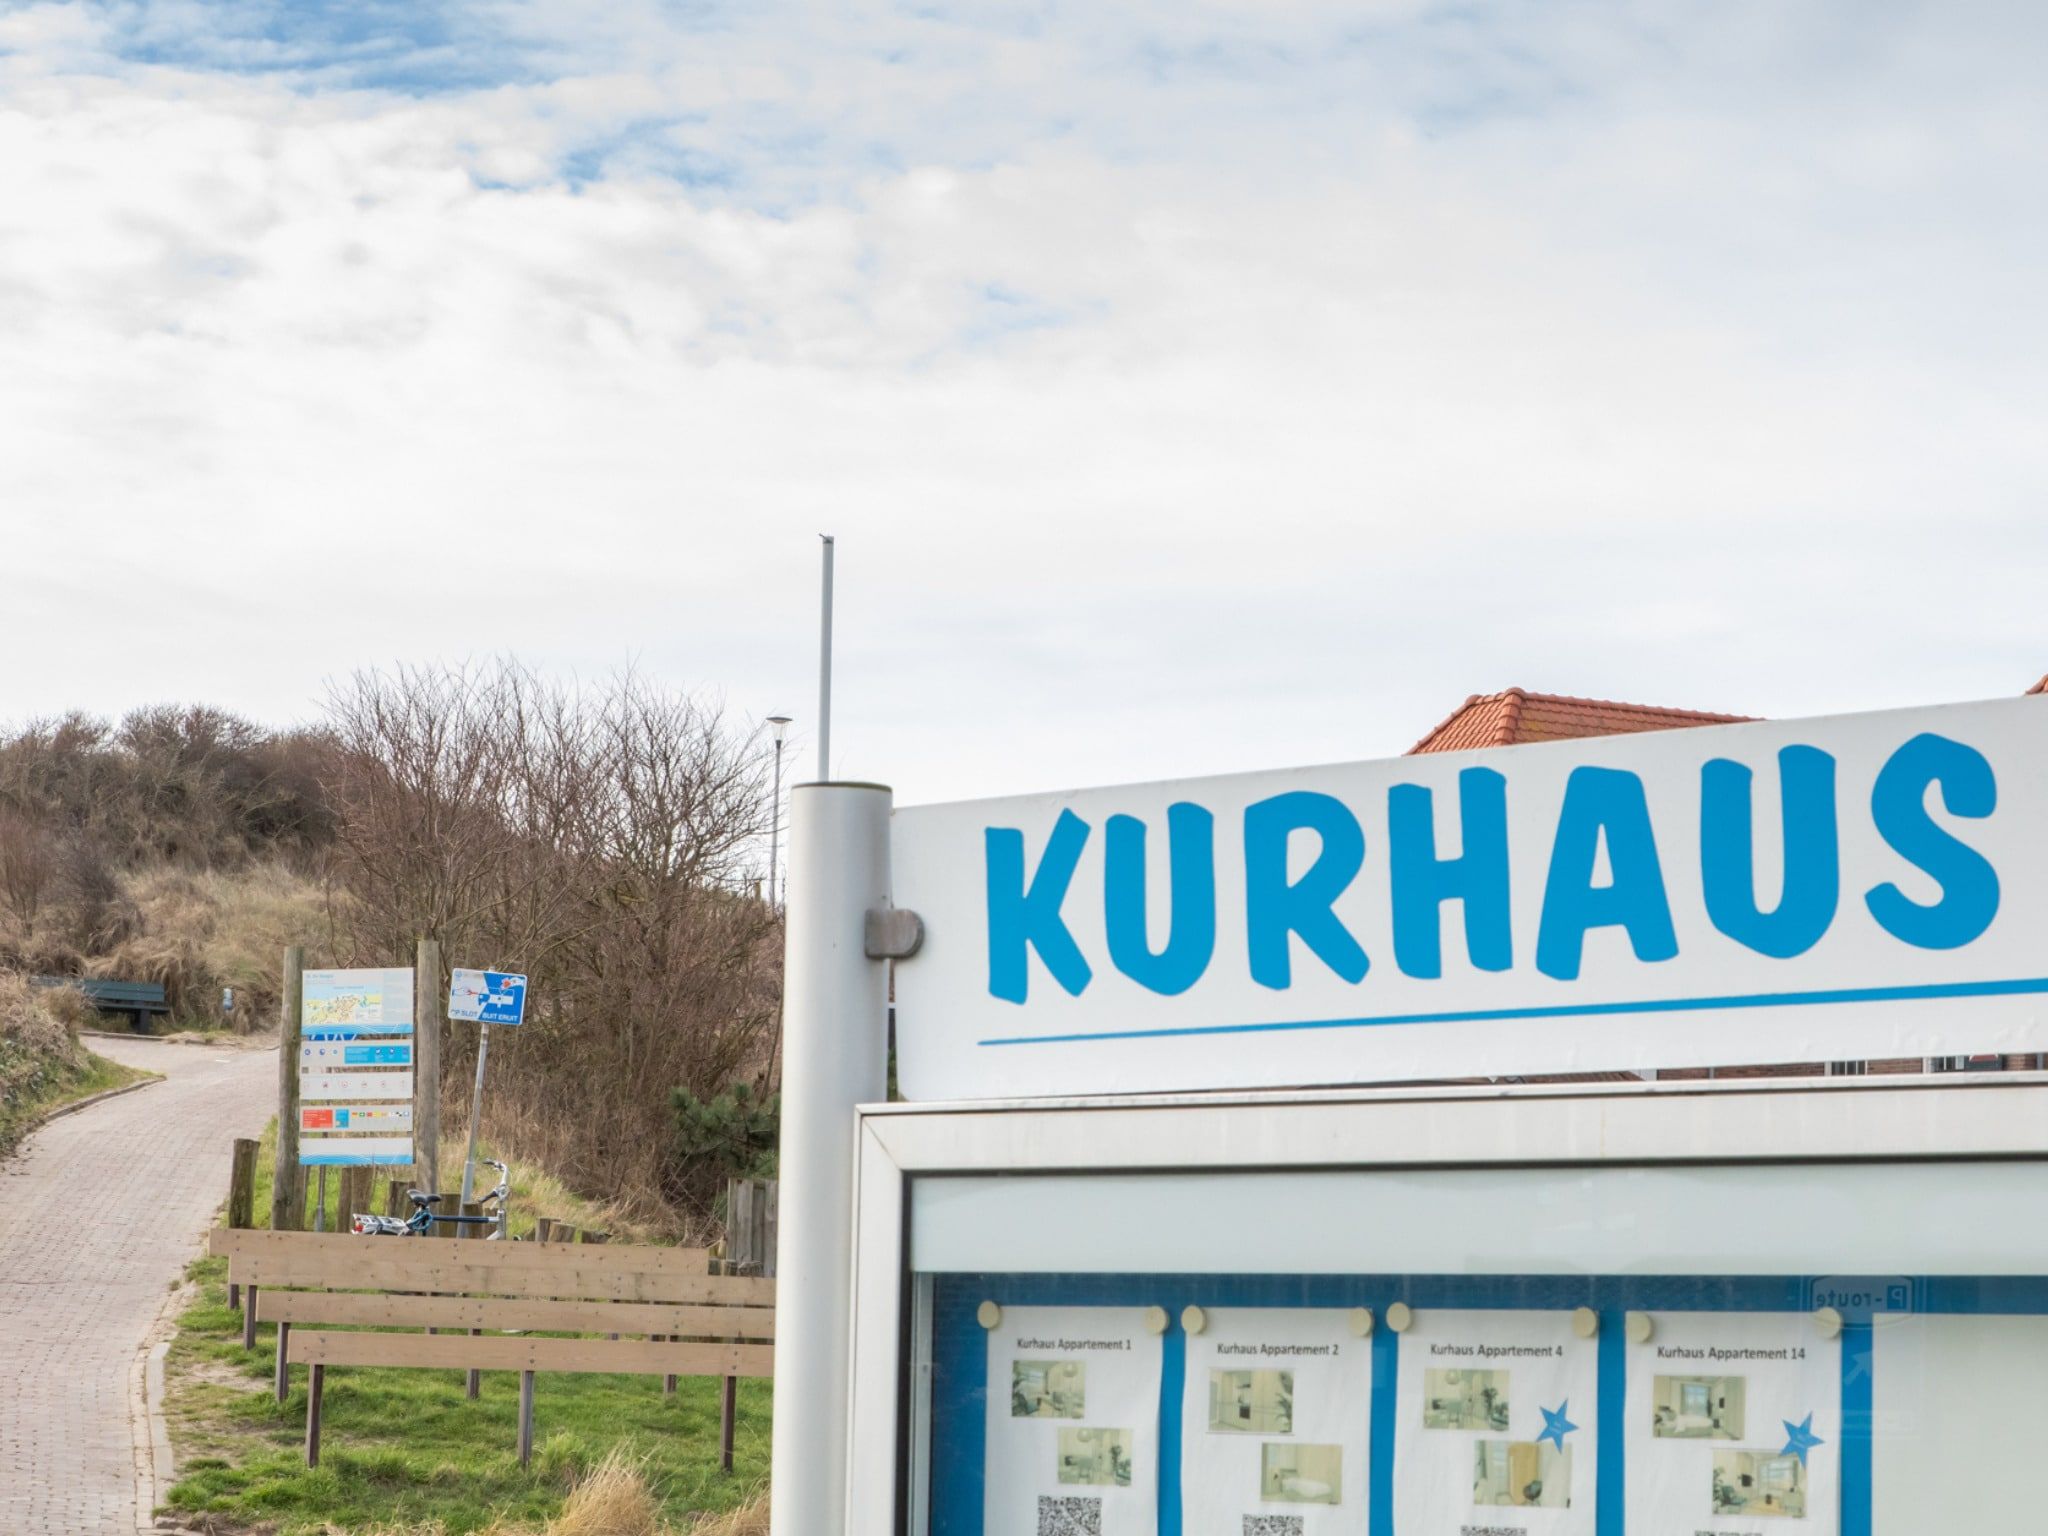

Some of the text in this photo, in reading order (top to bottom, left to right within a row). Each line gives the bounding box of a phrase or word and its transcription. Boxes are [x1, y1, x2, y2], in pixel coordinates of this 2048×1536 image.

[984, 732, 2002, 1006] KURHAUS
[1016, 1337, 1132, 1352] Kurhaus Appartement 1
[1217, 1343, 1339, 1357] Kurhaus Appartement 2
[1430, 1343, 1563, 1358] Kurhaus Appartement 4
[1657, 1345, 1806, 1361] Kurhaus Appartement 14
